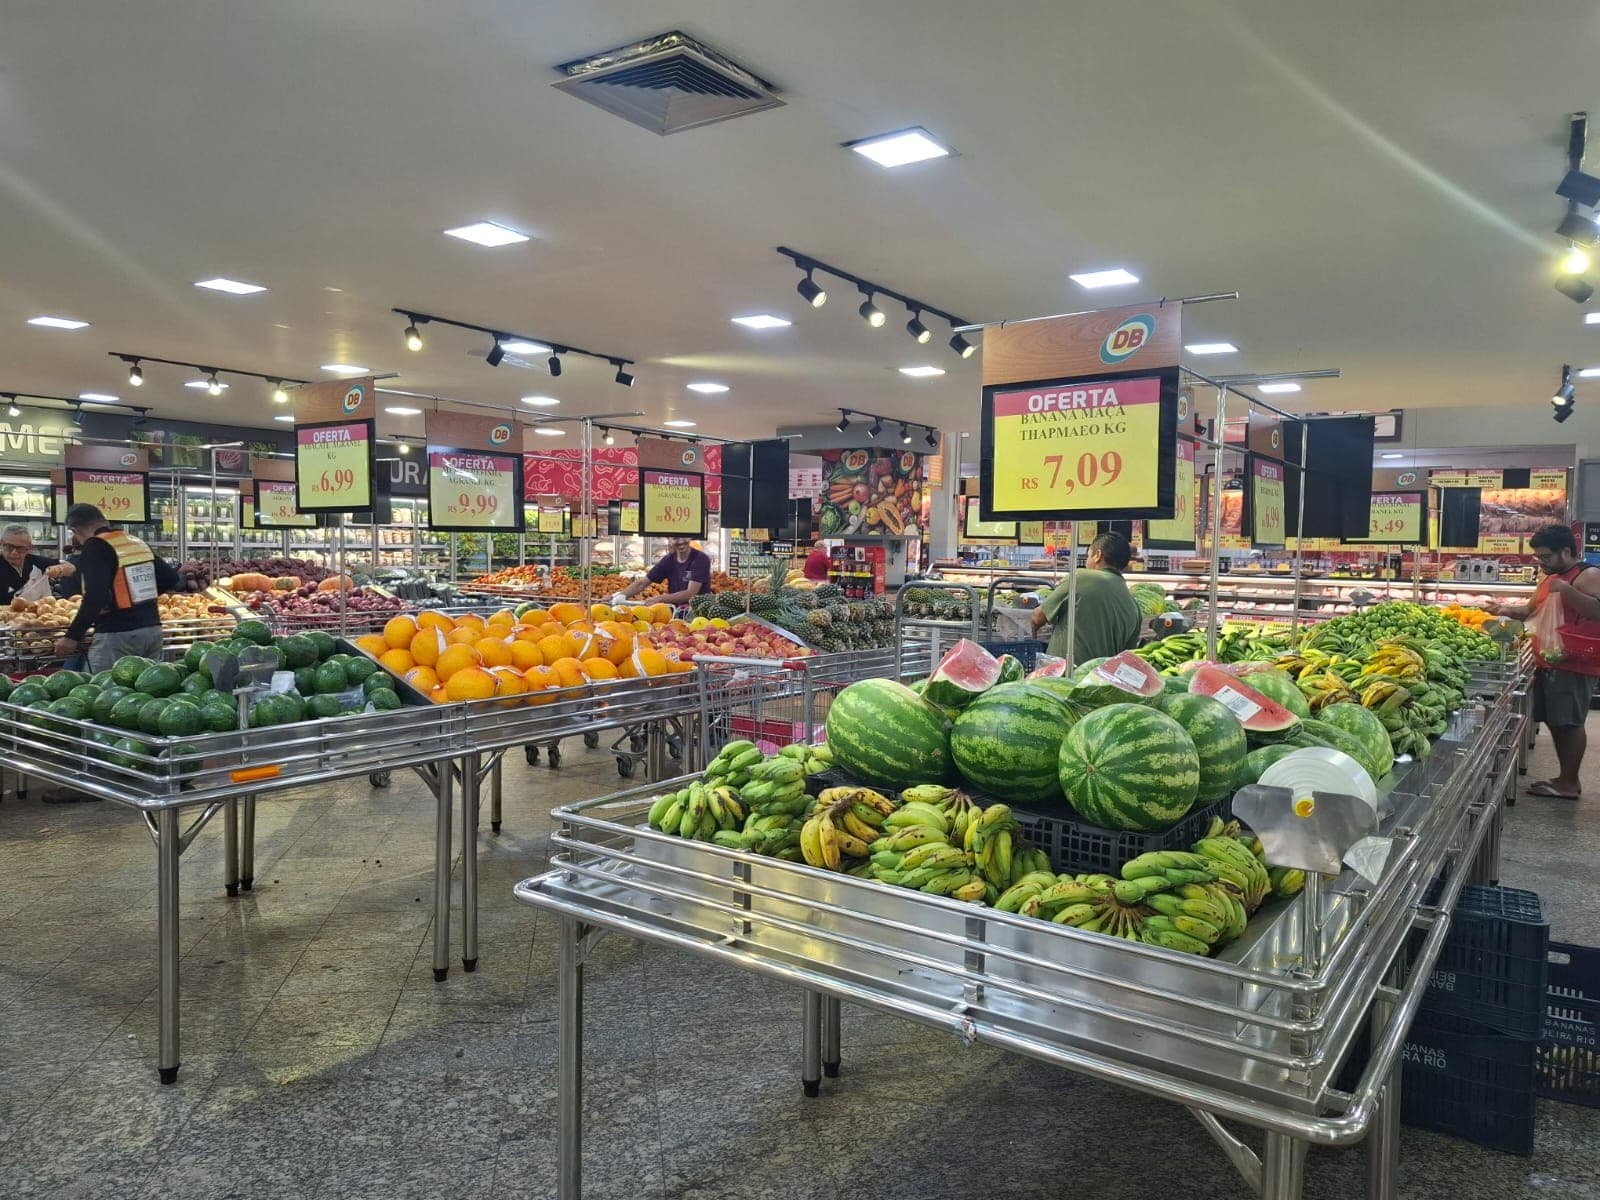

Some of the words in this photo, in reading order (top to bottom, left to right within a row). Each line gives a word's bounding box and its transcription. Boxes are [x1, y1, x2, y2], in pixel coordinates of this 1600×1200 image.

[1111, 328, 1144, 350] DB
[1028, 387, 1119, 413] OFERTA
[1020, 410, 1078, 425] BANANA
[313, 429, 351, 444] OFERTA
[1020, 424, 1099, 441] THAPMAEO
[1103, 421, 1127, 435] KG
[327, 451, 337, 461] KG
[451, 457, 495, 471] OFERTA
[849, 454, 867, 466] DB
[89, 474, 129, 484] OFERTA
[1043, 450, 1123, 495] 7,09
[1260, 464, 1278, 479] OFERTA
[321, 468, 354, 496] 6,99
[658, 475, 689, 486] OFERTA
[97, 496, 131, 513] 4,99
[458, 493, 499, 517] 9,99
[664, 505, 691, 524] 8,99
[1371, 519, 1405, 536] 3,49
[1544, 1017, 1596, 1036] BANANAS
[1576, 1034, 1596, 1046] RIO
[1423, 1054, 1447, 1070] RIO
